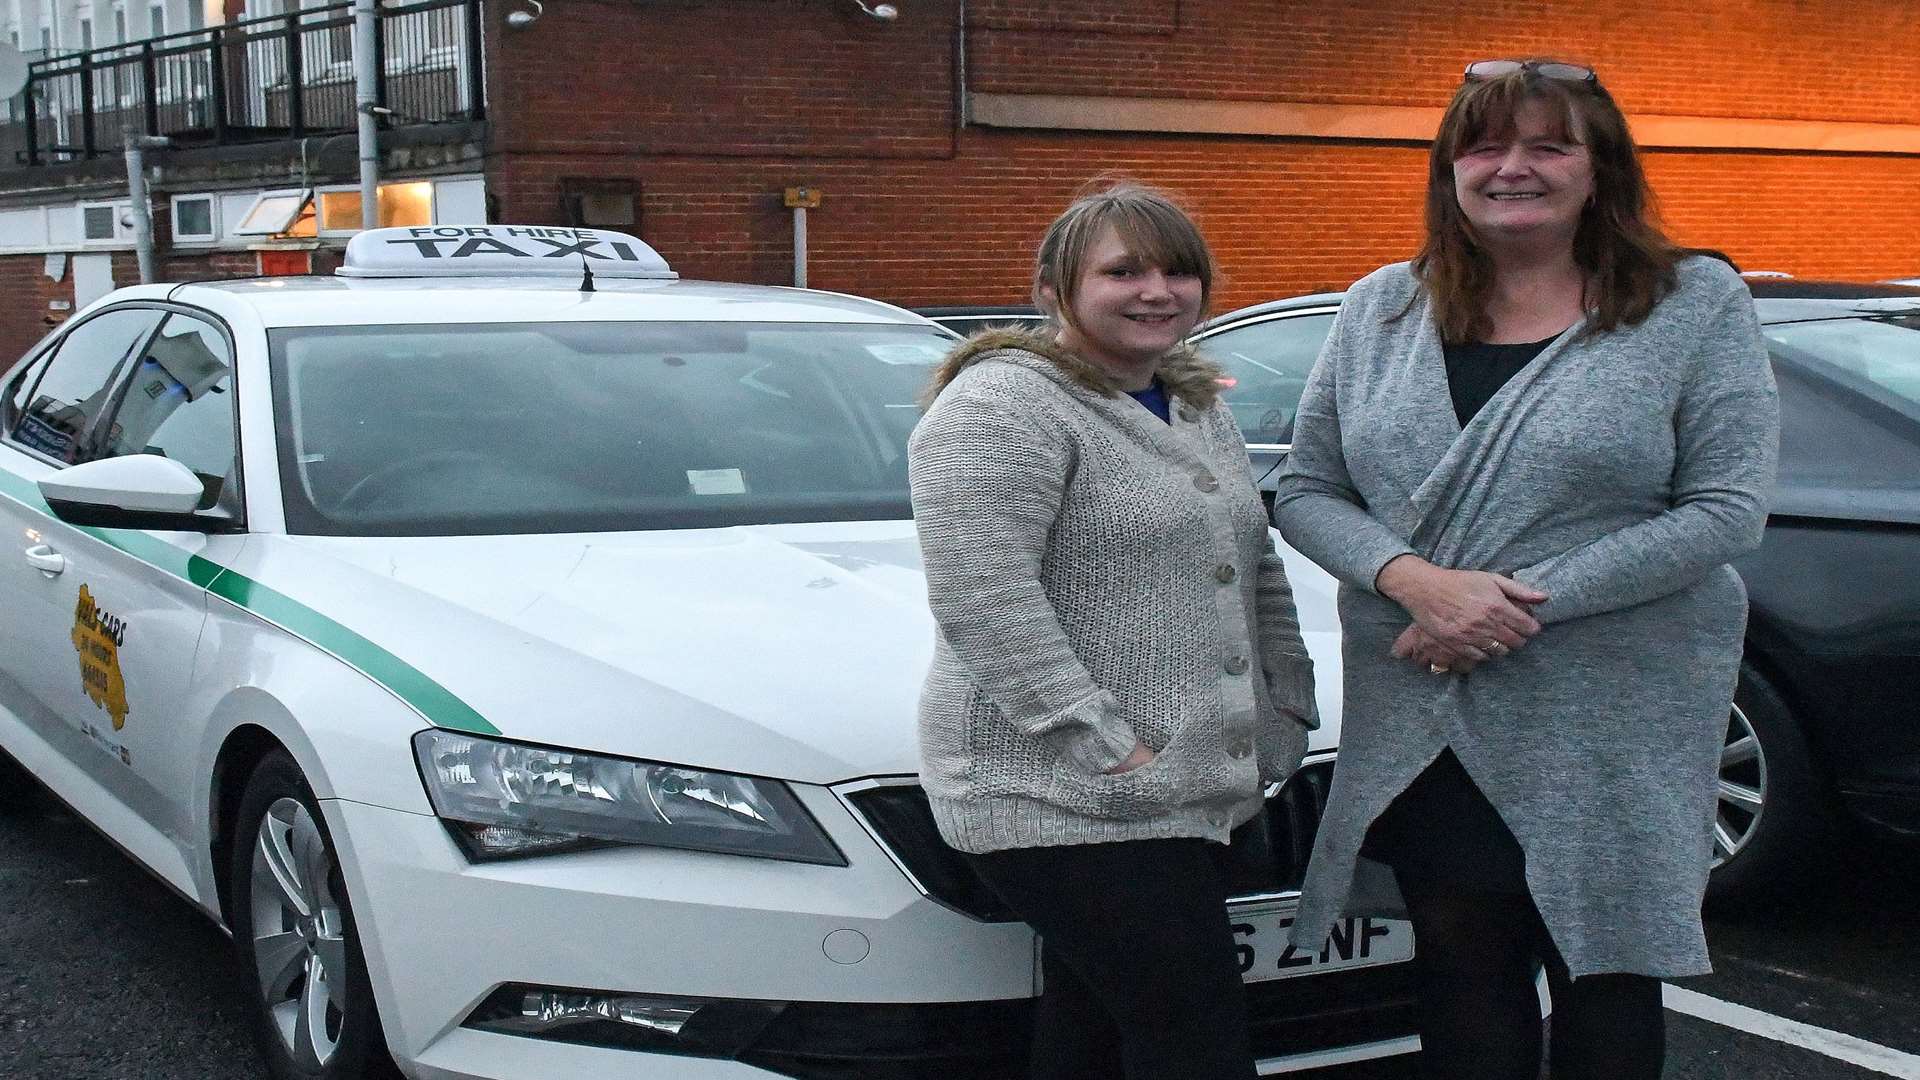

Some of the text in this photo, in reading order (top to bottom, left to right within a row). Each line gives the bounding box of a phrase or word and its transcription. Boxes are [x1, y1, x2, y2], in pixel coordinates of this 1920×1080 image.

[409, 227, 599, 240] FOR HIRE
[386, 238, 640, 262] TAXI
